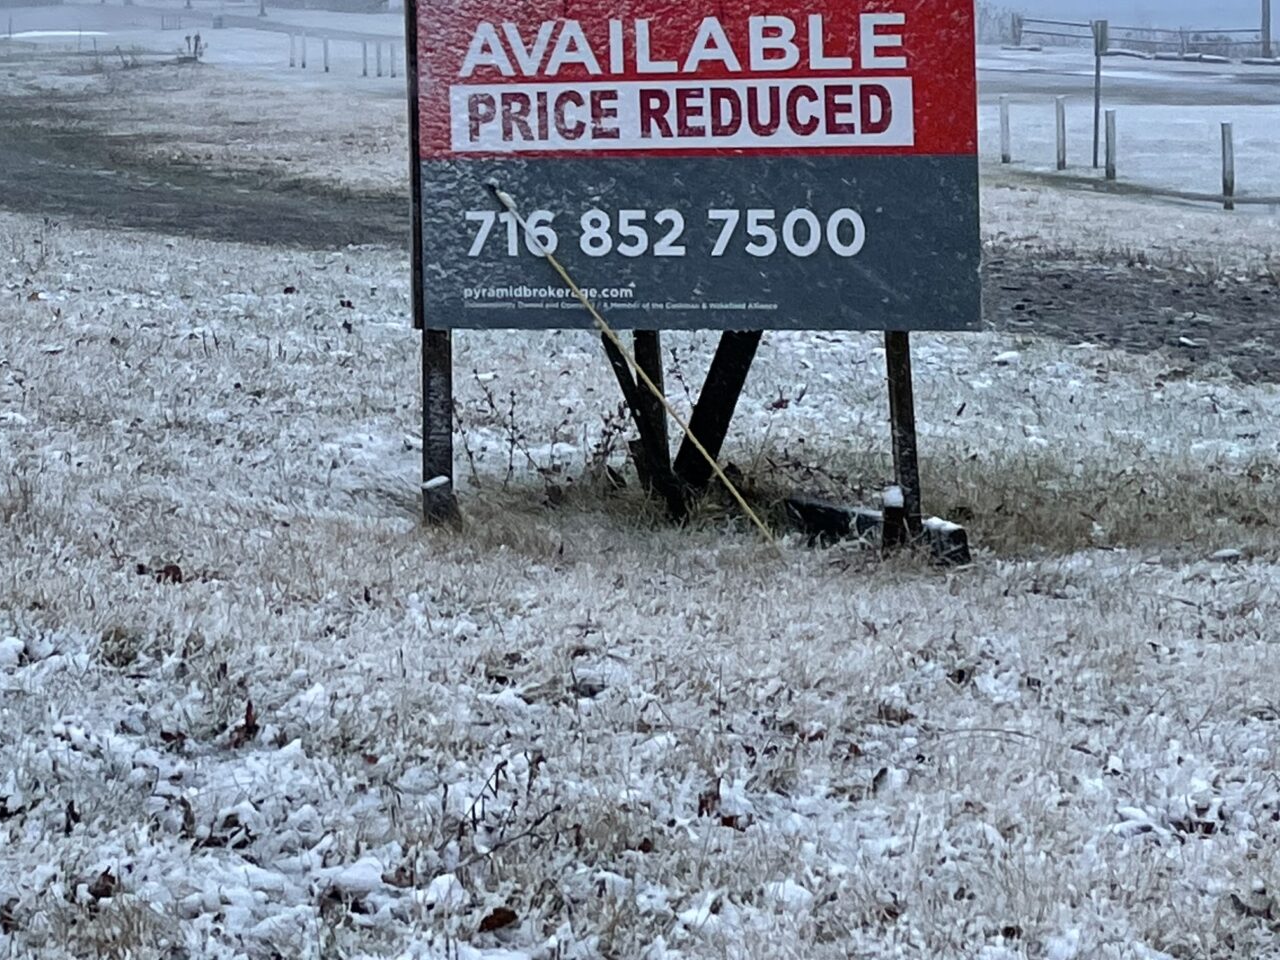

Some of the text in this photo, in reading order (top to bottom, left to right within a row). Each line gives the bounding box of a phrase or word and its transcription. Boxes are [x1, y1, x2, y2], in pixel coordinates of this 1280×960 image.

[458, 12, 907, 78] AVAILABLE
[468, 83, 893, 142] PRICE REDUCED
[464, 207, 867, 257] 716 852 7500
[463, 285, 633, 300] pyramidbrokerage.com
